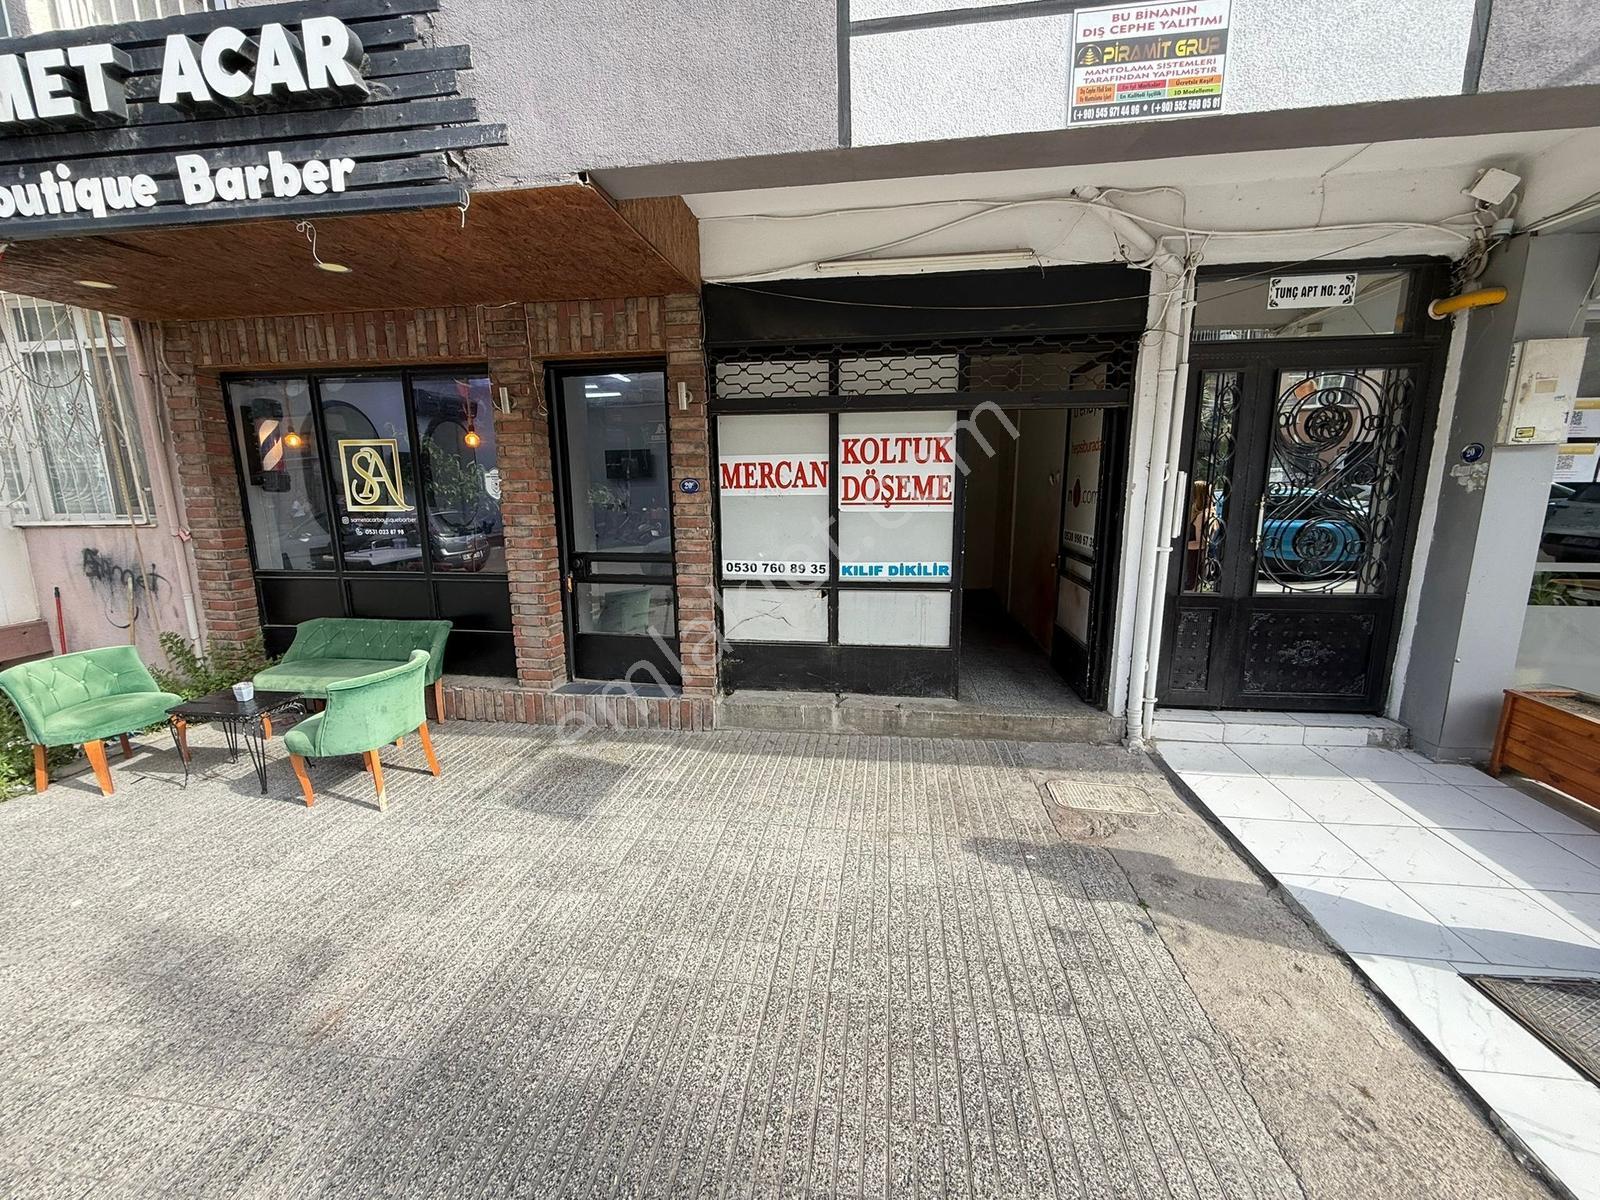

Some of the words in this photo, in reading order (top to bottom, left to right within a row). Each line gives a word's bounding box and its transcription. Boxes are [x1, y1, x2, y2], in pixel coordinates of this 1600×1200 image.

[1112, 12, 1130, 22] BU
[1136, 5, 1197, 19] BİNANIN
[1082, 27, 1105, 38] DIŞ
[1109, 22, 1155, 34] CEPHE
[1159, 15, 1223, 29] YALITIMI
[159, 16, 363, 105] ACAR
[1103, 38, 1172, 64] PİRAMİT
[1083, 73, 1150, 84] TARAFINDAN
[1085, 64, 1154, 76] MANTOLAMA
[176, 151, 355, 206] Barber
[1275, 286, 1299, 300] TUNÇ
[1301, 285, 1318, 297] APT
[1321, 284, 1336, 297] NO:
[1339, 284, 1351, 296] 20
[841, 436, 953, 465] KOLTUK
[720, 461, 829, 490] MERCAN
[841, 469, 952, 508] DÖŞEME
[726, 562, 758, 574] 0530
[762, 562, 786, 574] 760
[790, 563, 806, 575] 89
[810, 564, 827, 575] 35
[841, 565, 883, 576] KILIF
[888, 562, 950, 576] DİKİLİR
